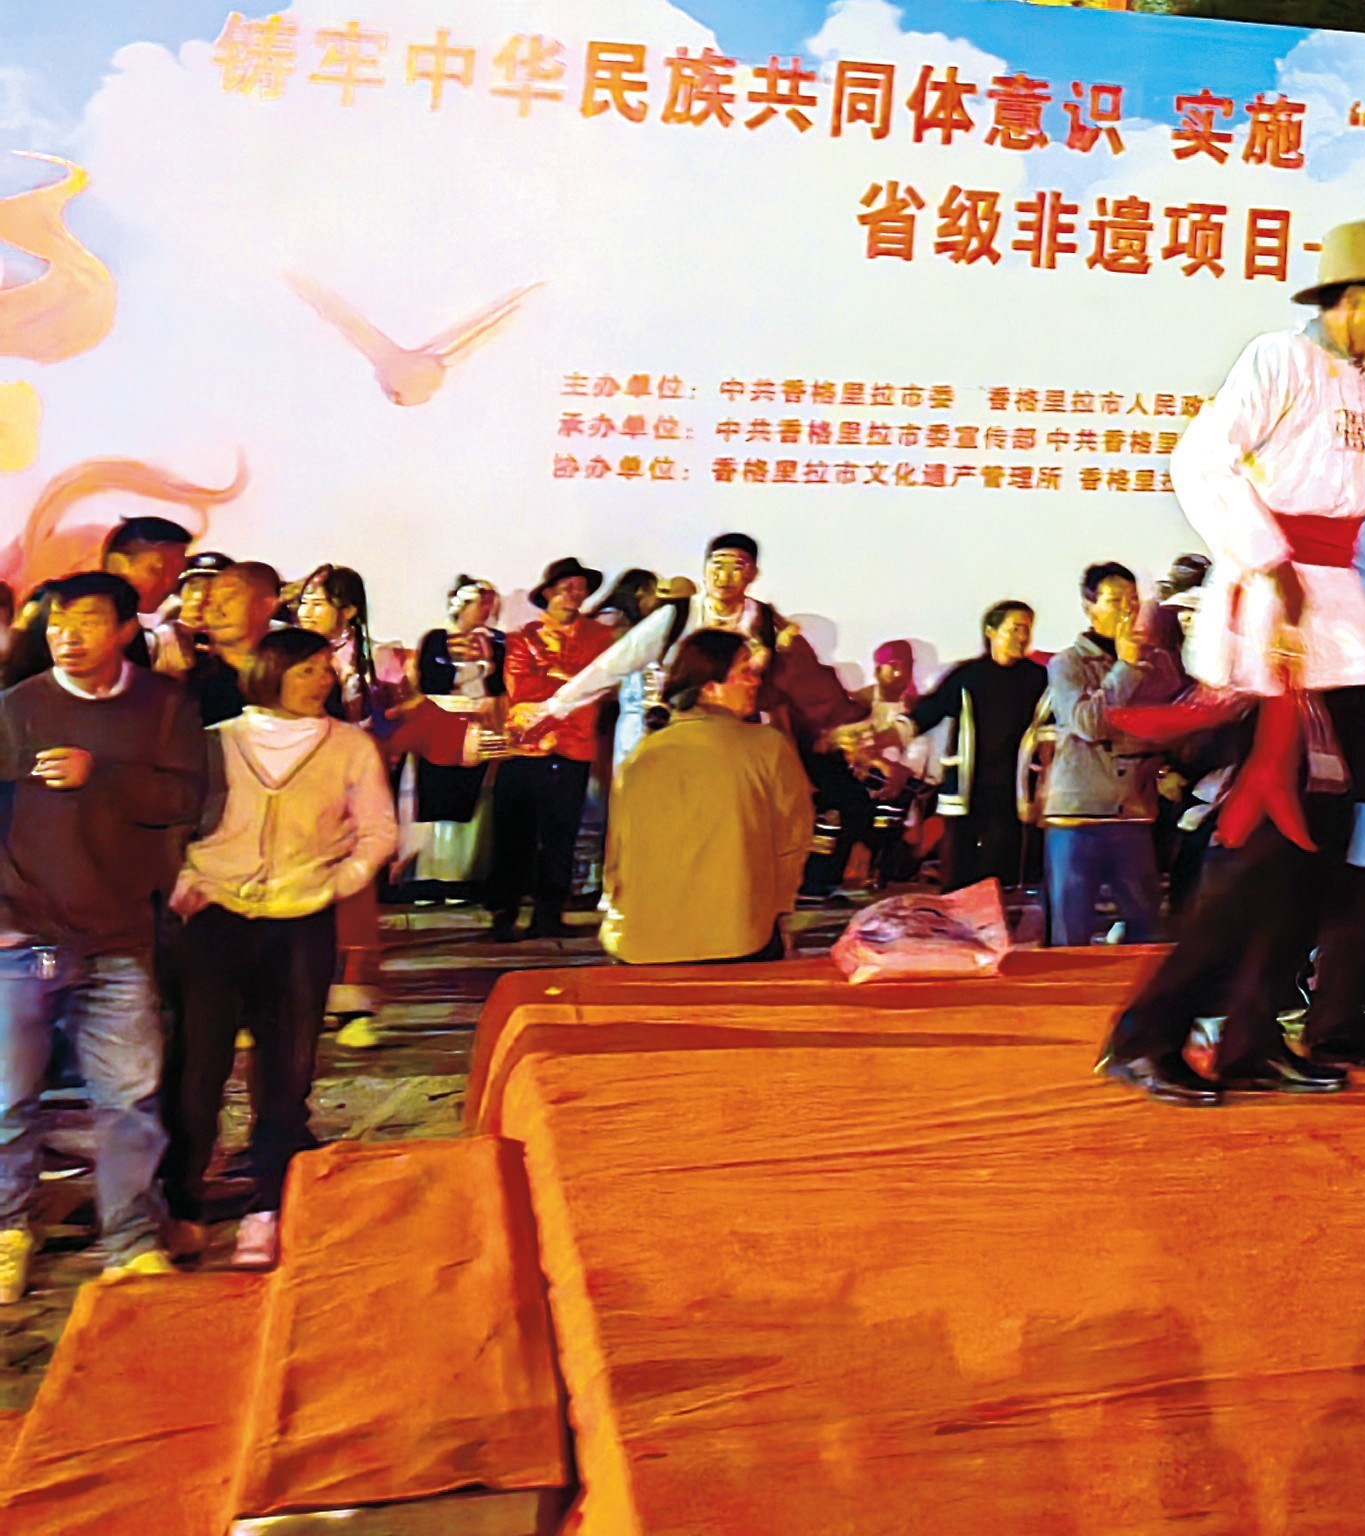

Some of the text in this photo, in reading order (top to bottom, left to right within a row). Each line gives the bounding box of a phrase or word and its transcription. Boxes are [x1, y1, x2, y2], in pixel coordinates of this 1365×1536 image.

[212, 12, 1124, 156] 铸牢中华民族共同体意识
[987, 386, 1216, 418] 香格里拉市人民政
